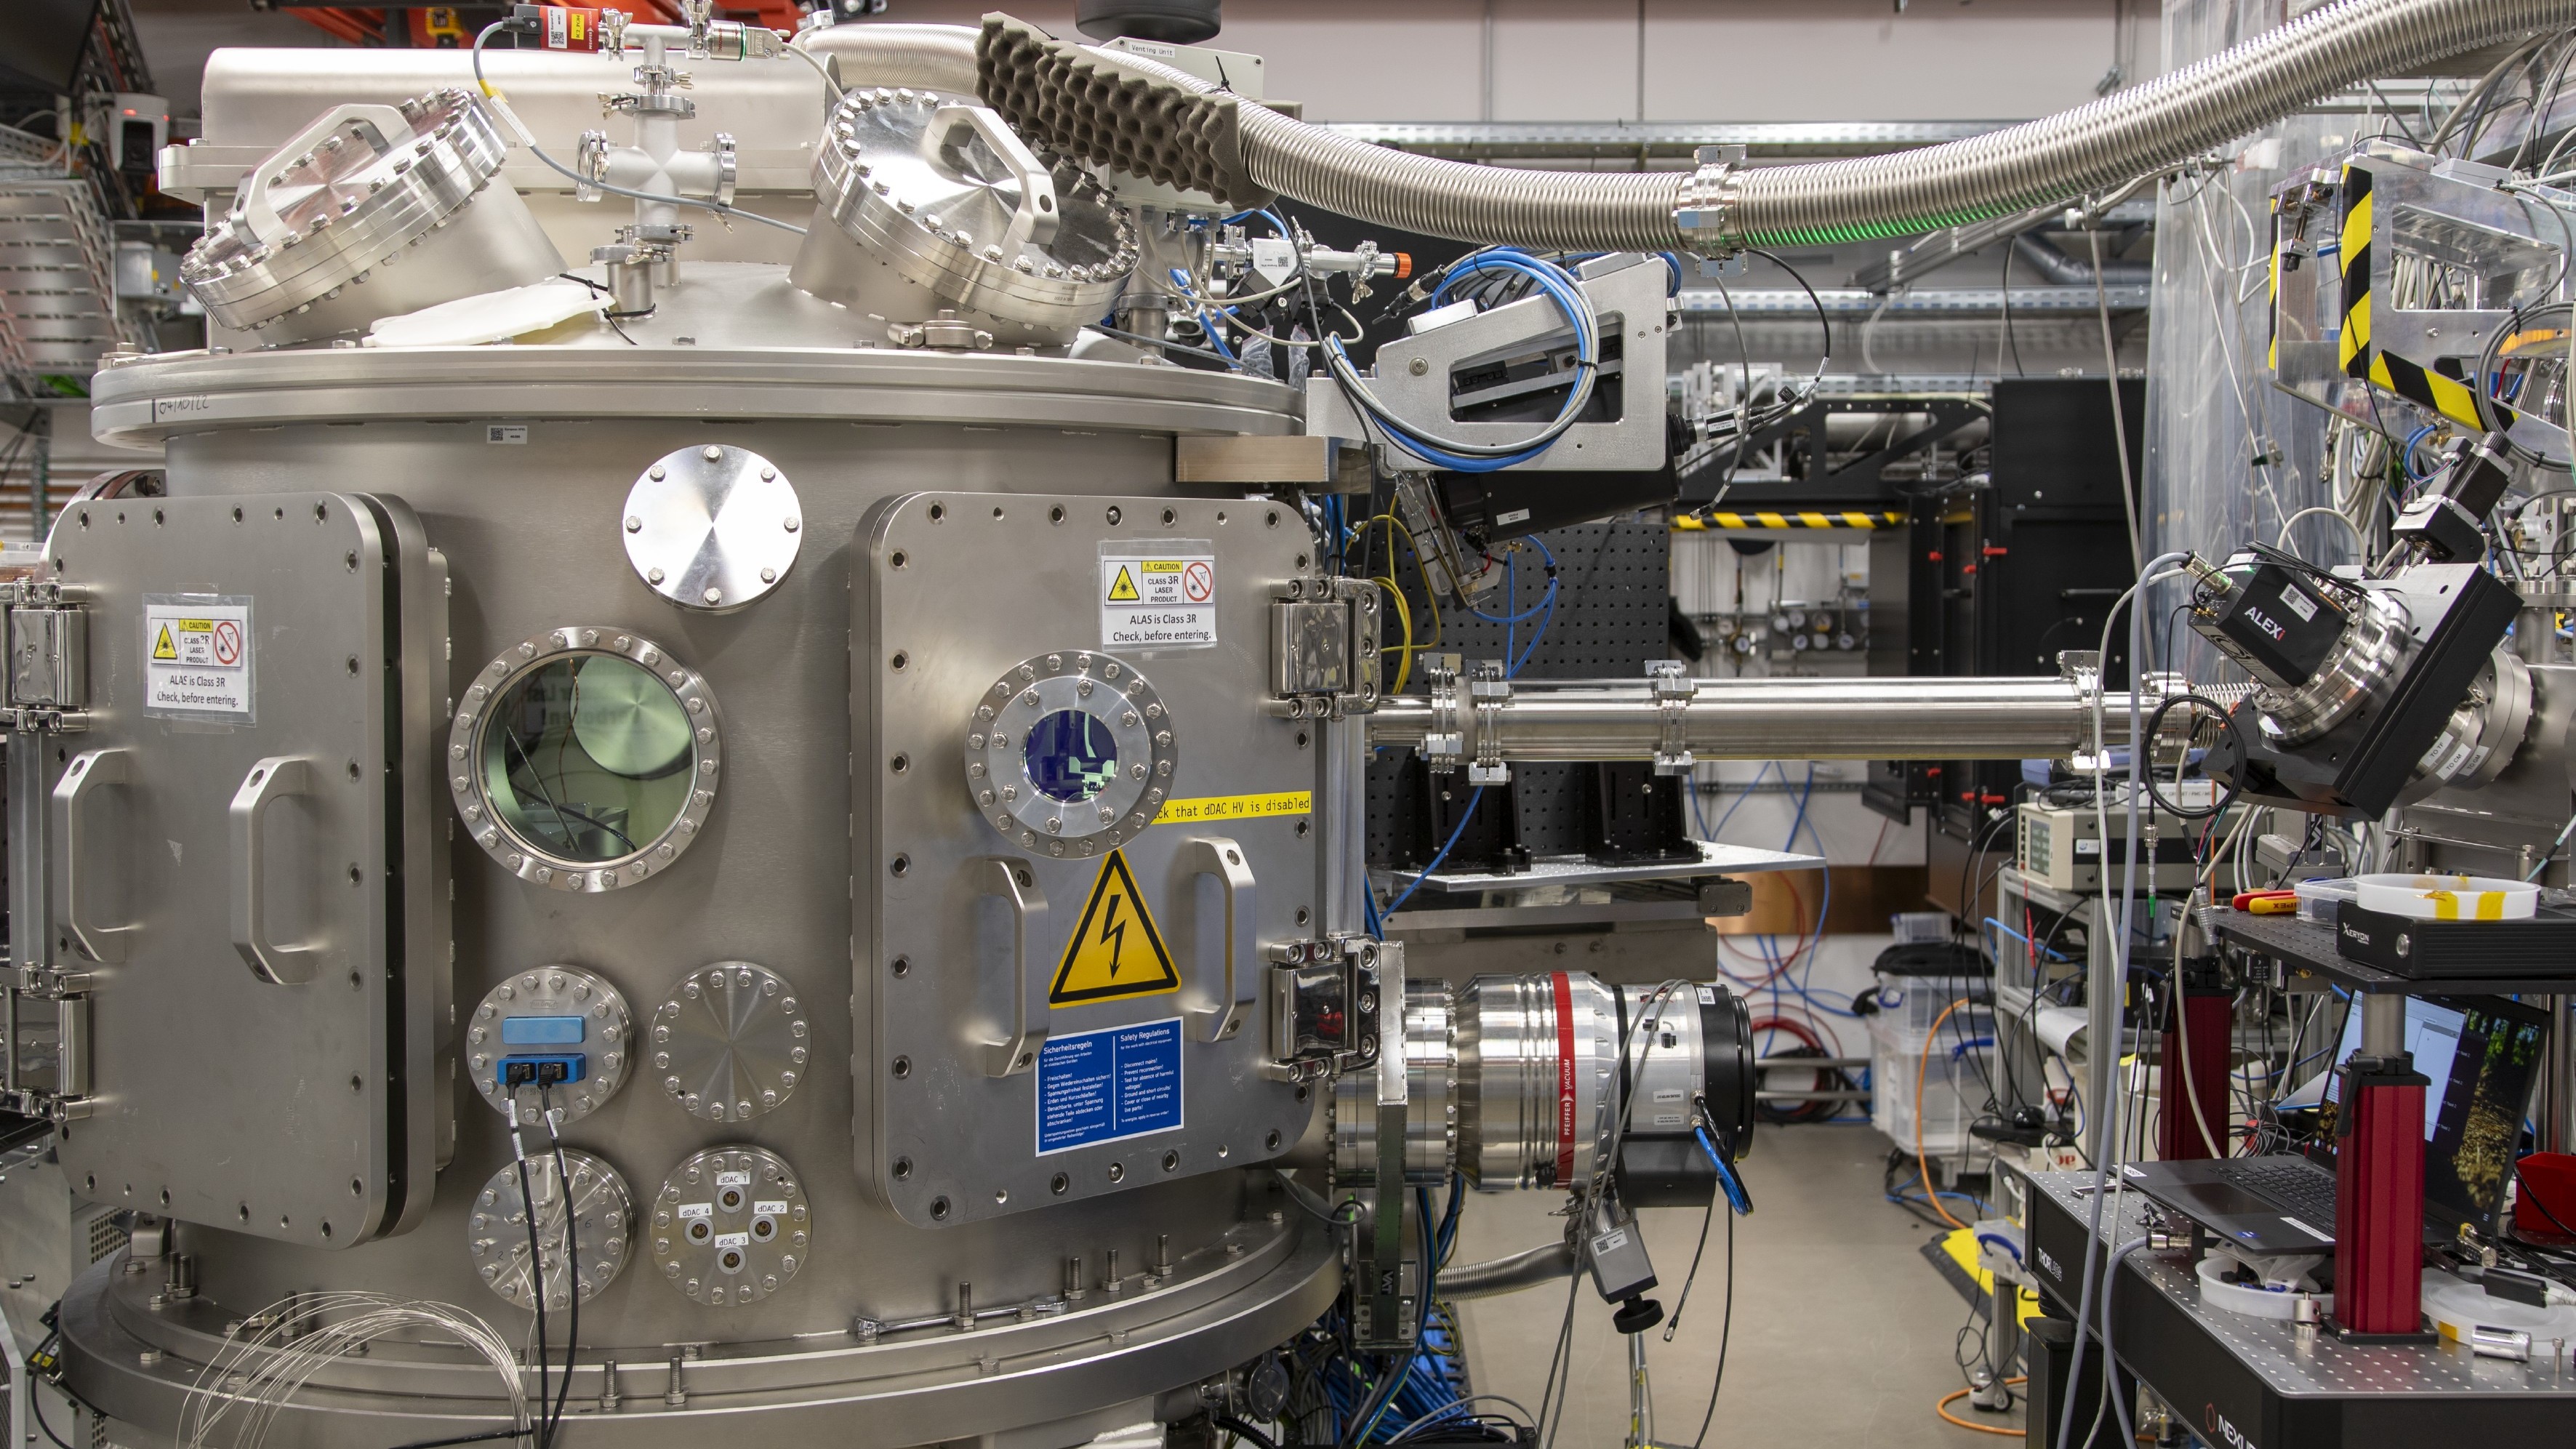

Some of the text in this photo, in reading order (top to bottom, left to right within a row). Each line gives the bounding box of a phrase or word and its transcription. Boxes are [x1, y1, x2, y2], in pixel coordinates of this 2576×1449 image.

[1131, 44, 1156, 55] Venting
[1168, 576, 1179, 585] 3R
[1130, 614, 1197, 625] ALAS is Class 3R
[2244, 606, 2286, 641] ALEXi
[1113, 630, 1211, 643] Check, before entering.
[170, 675, 225, 688] ALAS is Class 3R
[157, 691, 238, 708] Check, before entering.
[2430, 749, 2439, 758] TO
[2446, 762, 2455, 771] TO
[1176, 806, 1198, 818] that
[1204, 803, 1227, 816] dDAC
[1233, 801, 1244, 814] HV
[1251, 800, 1260, 813] is
[1266, 797, 1309, 811] disabled
[1139, 1029, 1169, 1040] Regulations
[1044, 1040, 1092, 1054] Sicherheitsregeln
[1139, 1064, 1163, 1073] reconnection!
[1047, 1073, 1072, 1082] Freischalten!
[1060, 1077, 1095, 1086] Wiedereinschalten
[1047, 1086, 1082, 1097] Spannungsfreiheit
[1126, 1082, 1141, 1091] voltages!
[1047, 1117, 1073, 1127] abschranken!
[2038, 1246, 2062, 1282] THORLABS
[1381, 1271, 1394, 1294] VAT
